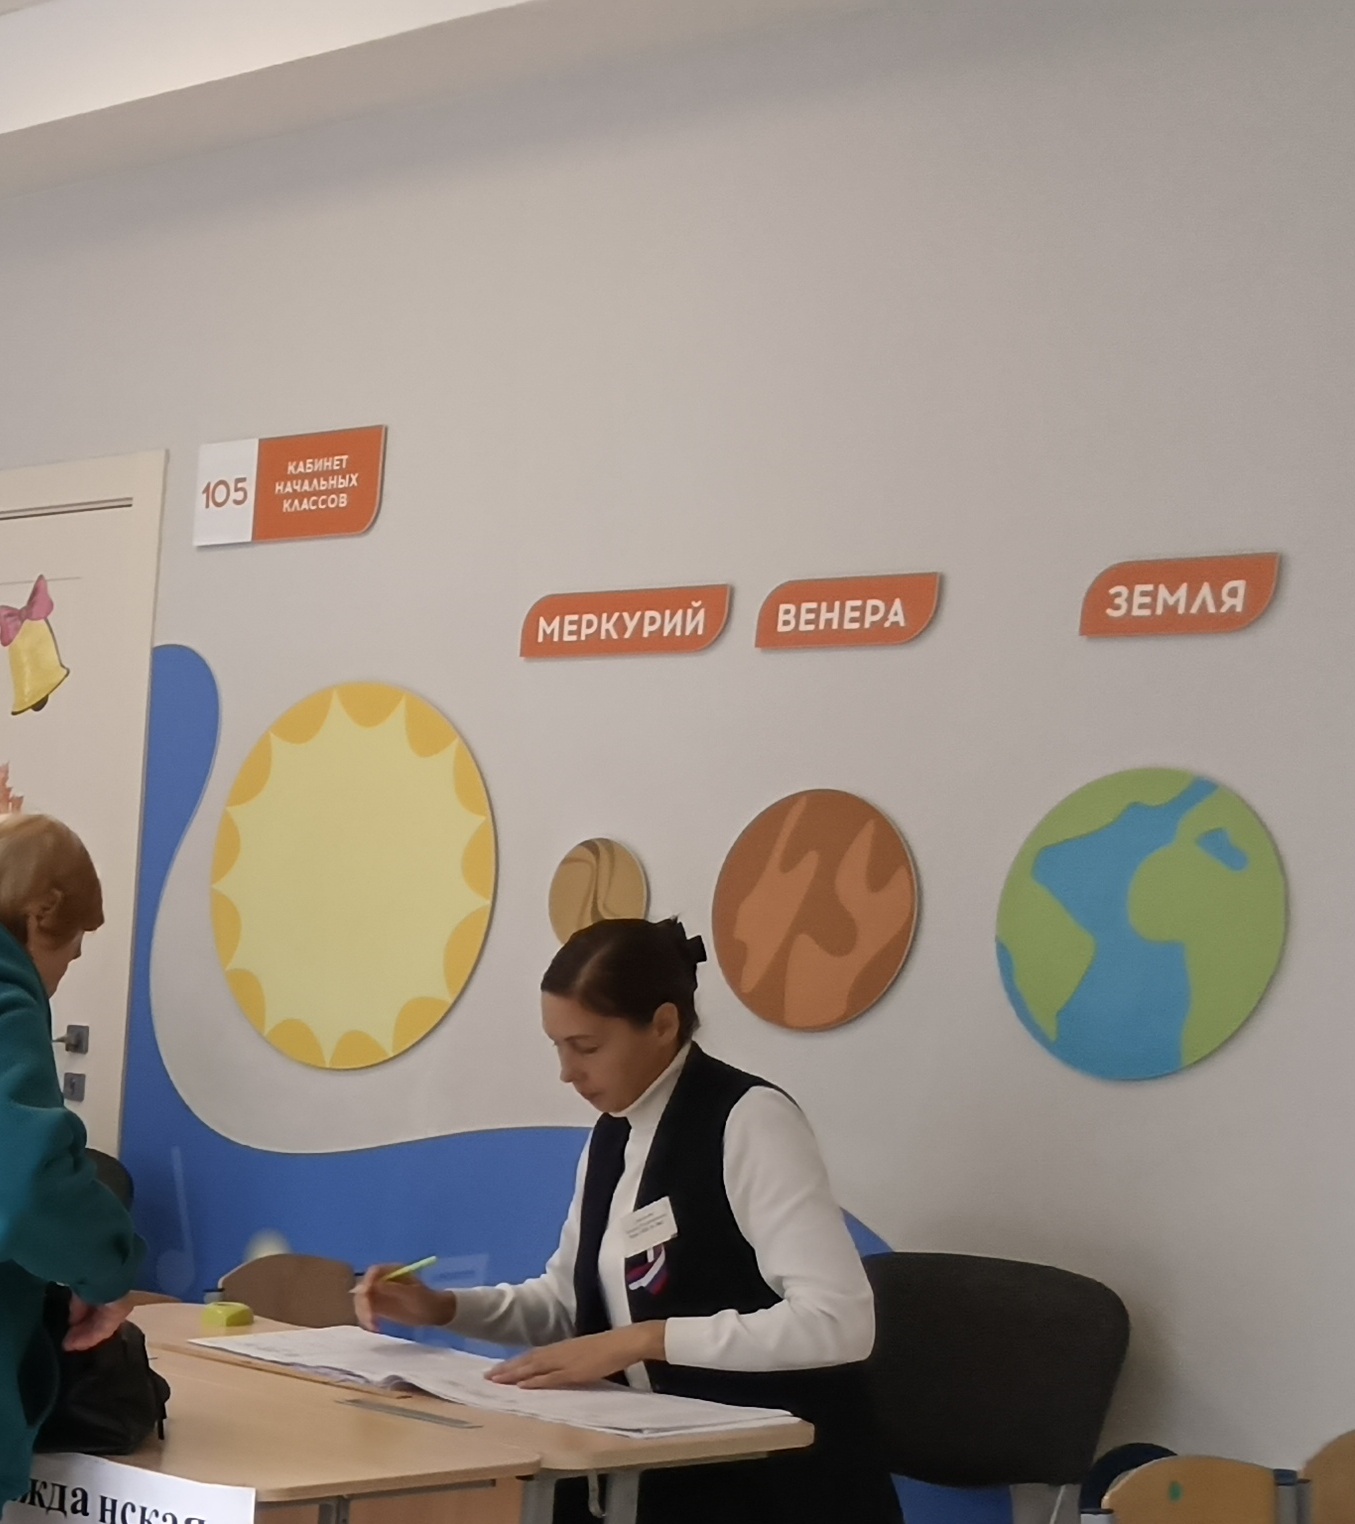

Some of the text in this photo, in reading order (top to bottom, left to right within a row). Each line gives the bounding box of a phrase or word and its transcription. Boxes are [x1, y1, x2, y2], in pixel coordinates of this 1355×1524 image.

[287, 455, 349, 475] КАБИНЕТ
[202, 477, 248, 509] 105
[275, 473, 359, 494] НАЧАЛЬНЫХ
[282, 493, 348, 513] КЛАССОВ
[1106, 579, 1247, 618] ЗЕМЛЯ
[537, 600, 706, 643] МЕРКУРИЙ
[777, 598, 906, 633] ВЕНЕРА
